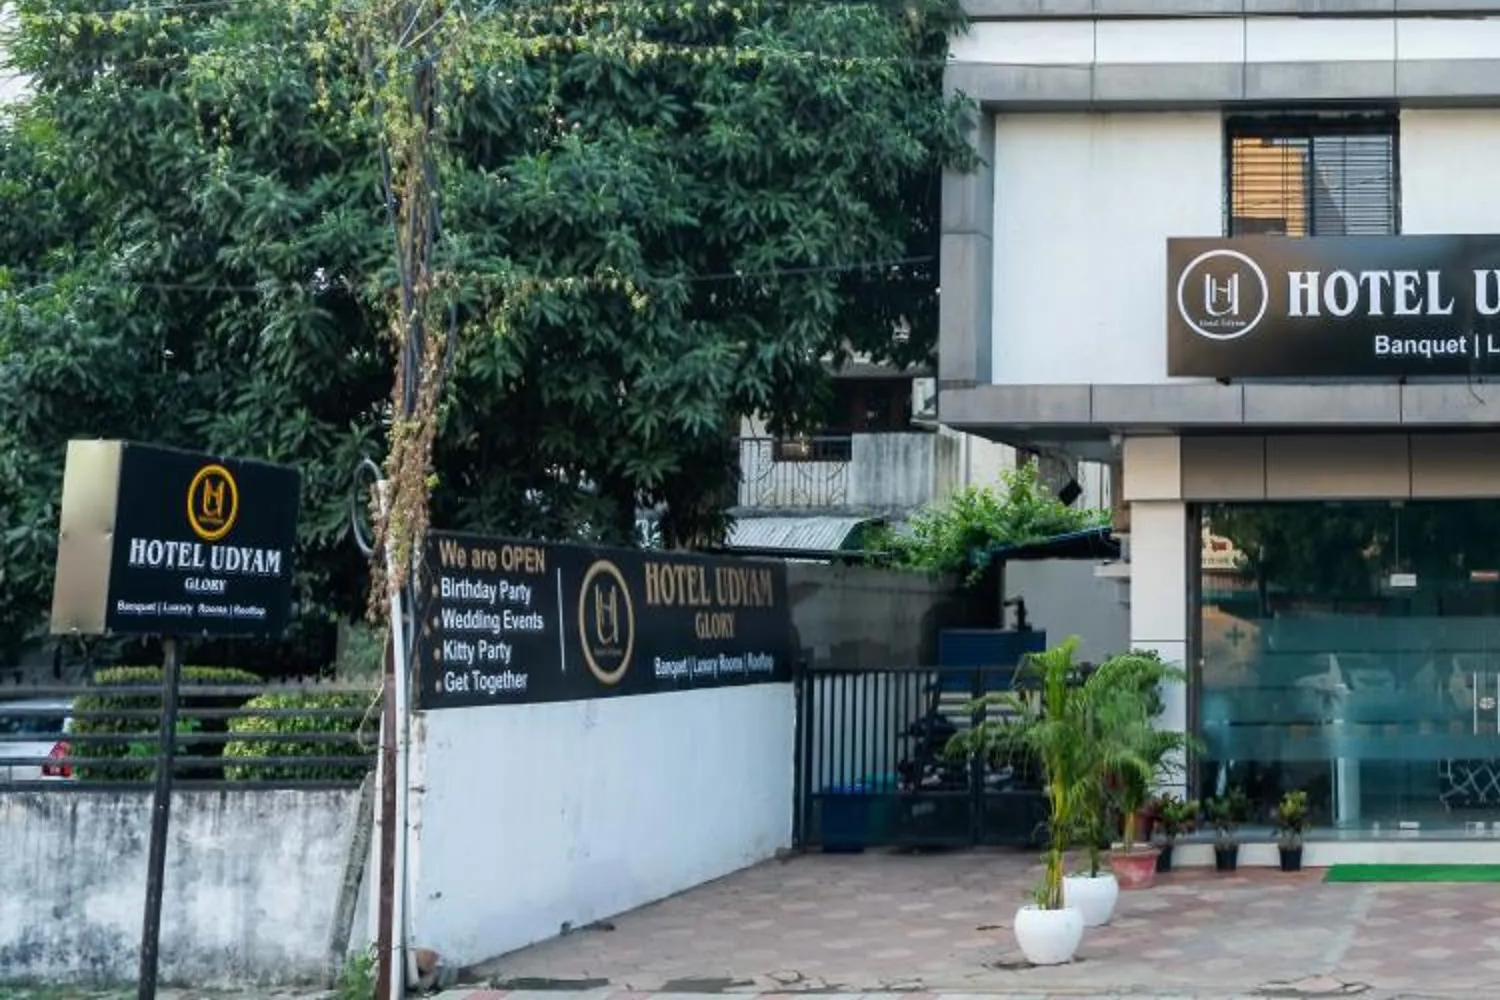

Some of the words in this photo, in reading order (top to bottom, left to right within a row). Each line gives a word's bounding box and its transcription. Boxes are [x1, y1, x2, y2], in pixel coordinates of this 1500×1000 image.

[1287, 268, 1455, 318] HOTEL
[1374, 334, 1467, 357] Banquet
[129, 538, 205, 568] HOTEL
[210, 546, 282, 573] UDYAM
[440, 540, 467, 568] We
[471, 548, 497, 571] are
[501, 544, 545, 573] OPEN
[185, 577, 227, 592] GLORY
[441, 577, 497, 605] Birthday
[499, 580, 532, 605] Party
[644, 562, 711, 606] HOTEL
[715, 566, 774, 607] UDYAM
[442, 608, 500, 634] Wedding
[503, 609, 544, 630] Events
[695, 611, 736, 639] GLORY
[443, 639, 475, 665] Kitty
[478, 640, 512, 665] Party
[445, 671, 469, 693] Get
[472, 669, 528, 695] Together
